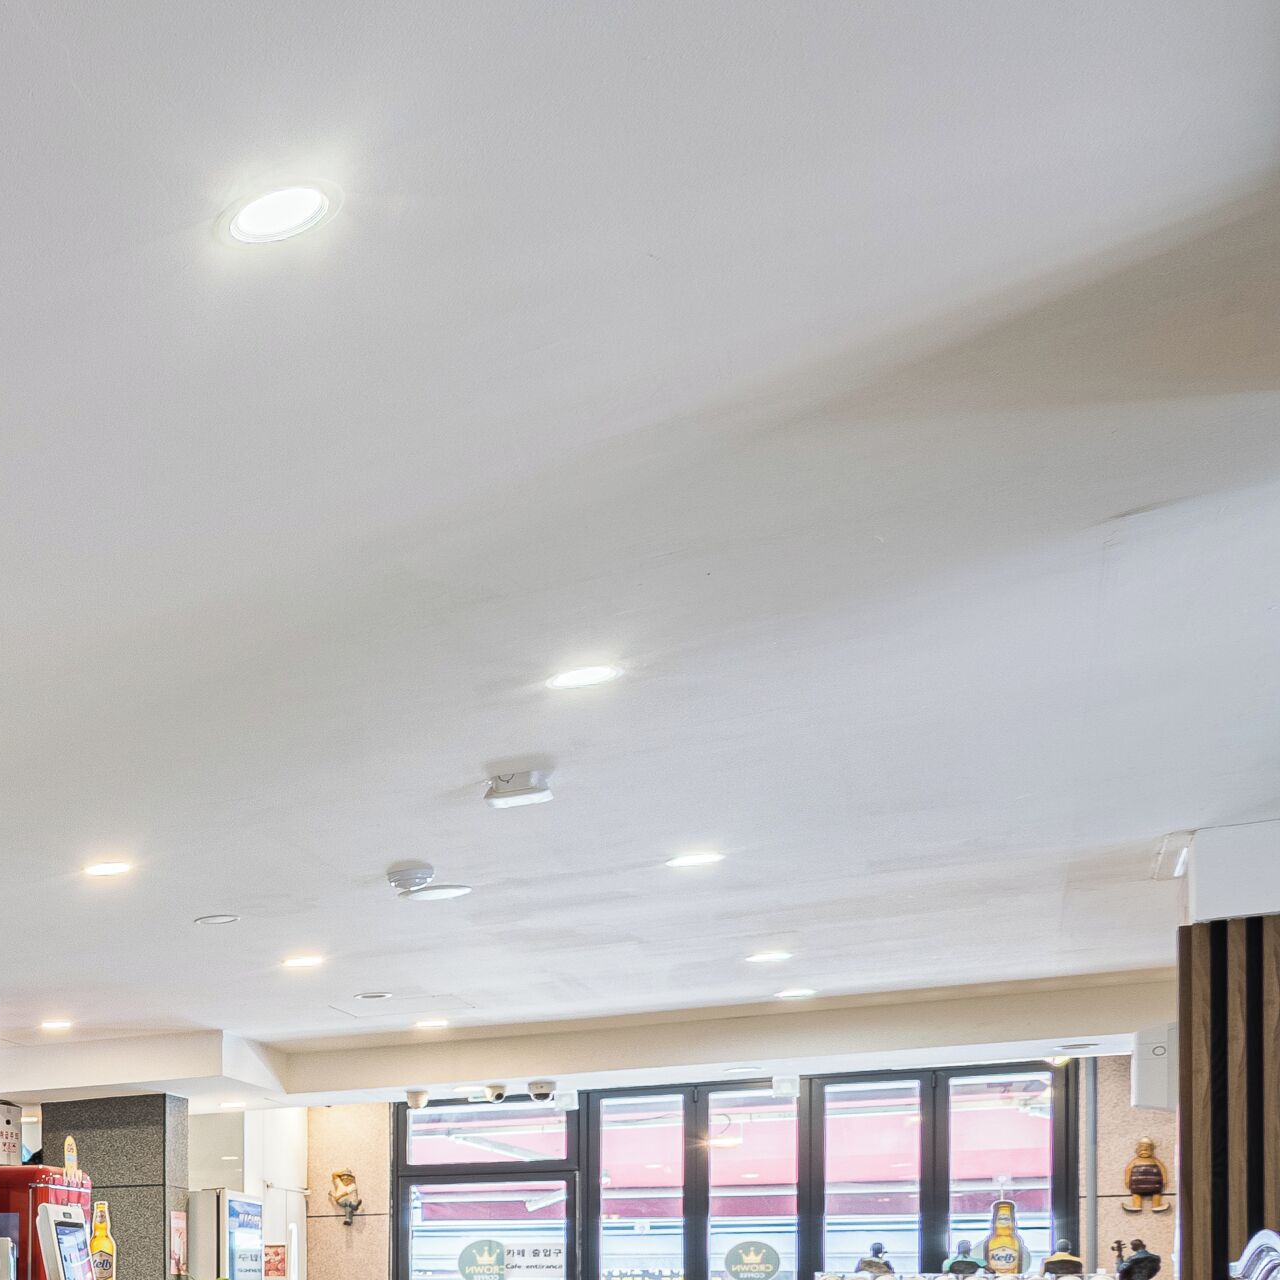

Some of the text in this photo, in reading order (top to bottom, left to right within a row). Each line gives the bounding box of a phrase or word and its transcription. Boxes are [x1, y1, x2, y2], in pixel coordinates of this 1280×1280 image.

[505, 1249, 562, 1257] 카페 출입구
[991, 1253, 1015, 1264] Kelly
